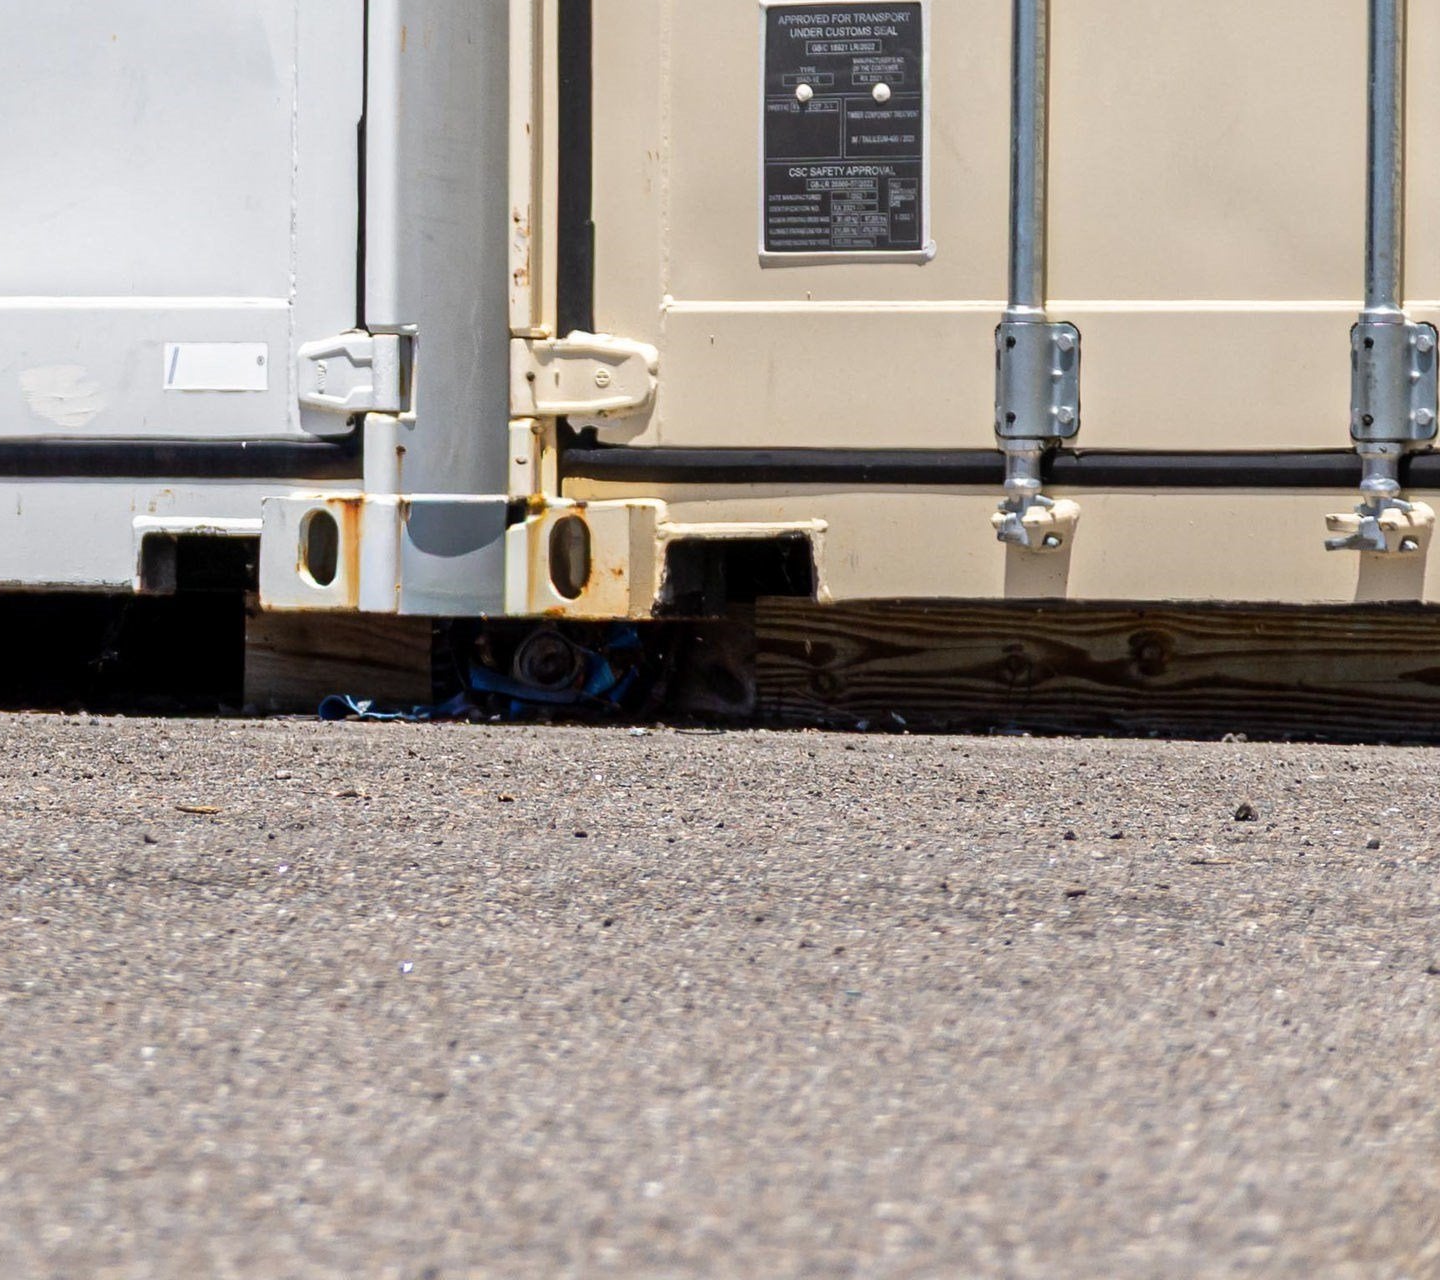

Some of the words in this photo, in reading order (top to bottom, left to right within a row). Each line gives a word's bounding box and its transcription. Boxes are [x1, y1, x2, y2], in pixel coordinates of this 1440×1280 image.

[778, 13, 829, 25] APPROVED
[831, 13, 852, 24] FOR
[854, 12, 911, 23] TRANSPORT
[790, 27, 823, 37] UNDER
[825, 26, 871, 37] CUSTOMS
[874, 25, 898, 36] SEAL
[789, 168, 807, 178] CSC
[809, 166, 845, 177] SAFETY
[846, 165, 896, 176] APPROVAL
